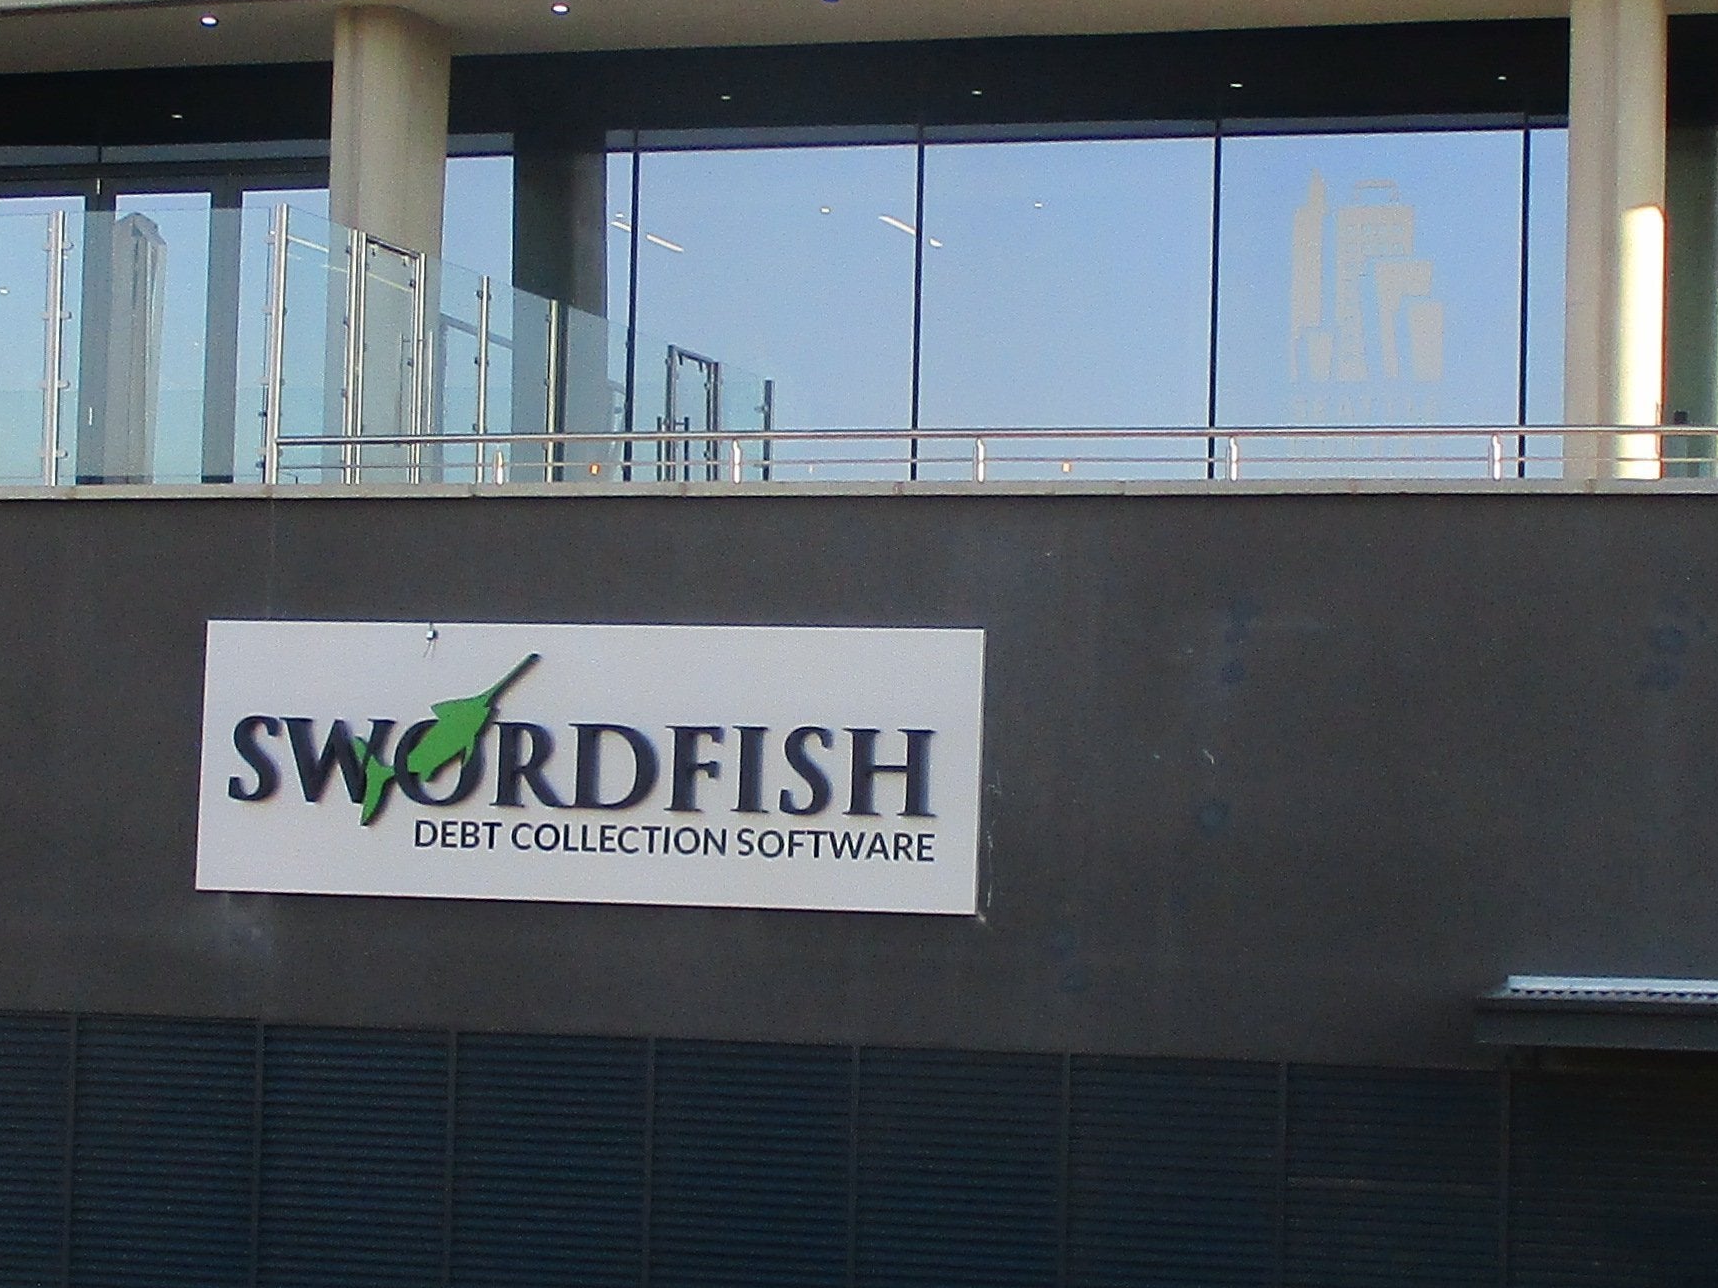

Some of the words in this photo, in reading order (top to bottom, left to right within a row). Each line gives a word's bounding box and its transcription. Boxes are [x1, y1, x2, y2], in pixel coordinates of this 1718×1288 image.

[226, 714, 936, 818] SWORDFISH
[413, 819, 502, 851] DEBT
[511, 823, 728, 857] COLLECTION
[737, 829, 934, 862] SOFTWARE
